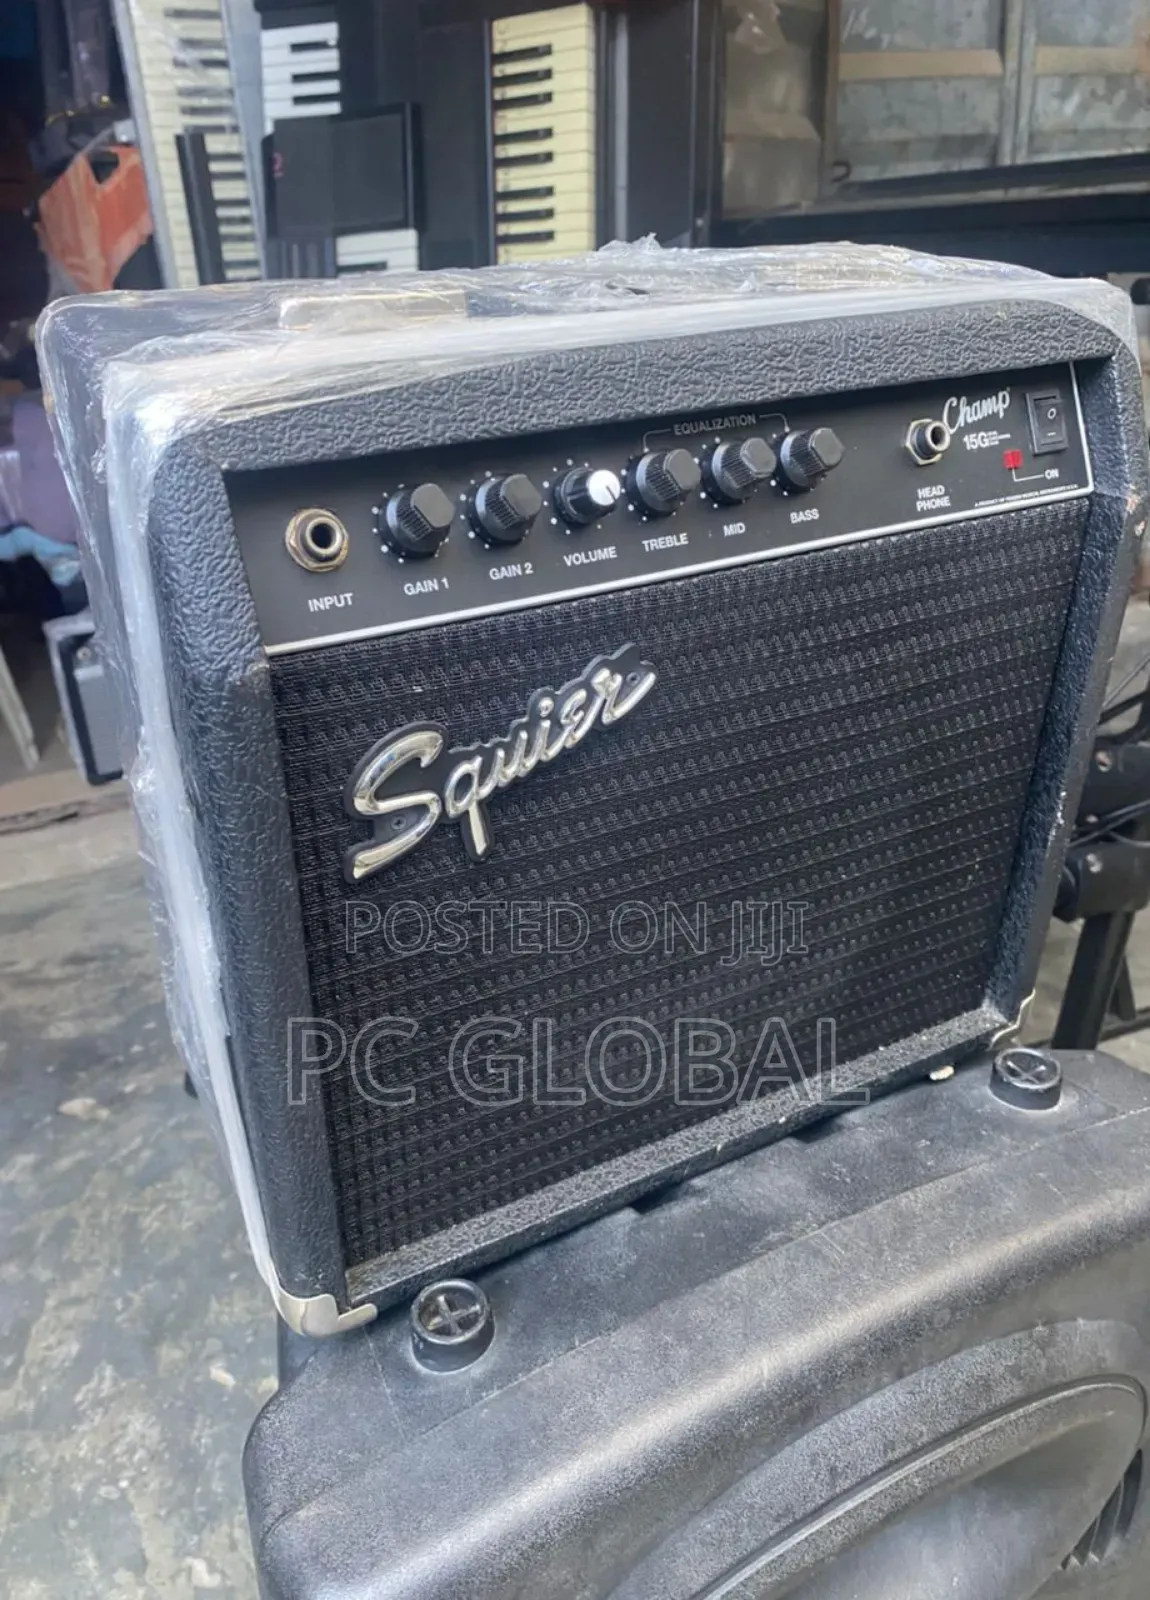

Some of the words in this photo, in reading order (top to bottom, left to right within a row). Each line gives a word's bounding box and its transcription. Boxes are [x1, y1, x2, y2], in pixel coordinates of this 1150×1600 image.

[942, 390, 1010, 434] Champ
[674, 414, 757, 436] EQUALIZATION
[1044, 468, 1059, 479] ON
[917, 485, 945, 497] HEAD
[916, 497, 951, 511] PHONE
[790, 509, 820, 524] BASS
[723, 522, 746, 537] MID
[642, 533, 689, 552] TREBLE
[563, 546, 618, 567] VOLUME
[488, 564, 522, 581] GAIN
[523, 562, 534, 575] 2
[404, 578, 439, 596] GAIN
[440, 577, 450, 590] 1
[308, 592, 355, 613] INPUT
[350, 666, 658, 880] Squier
